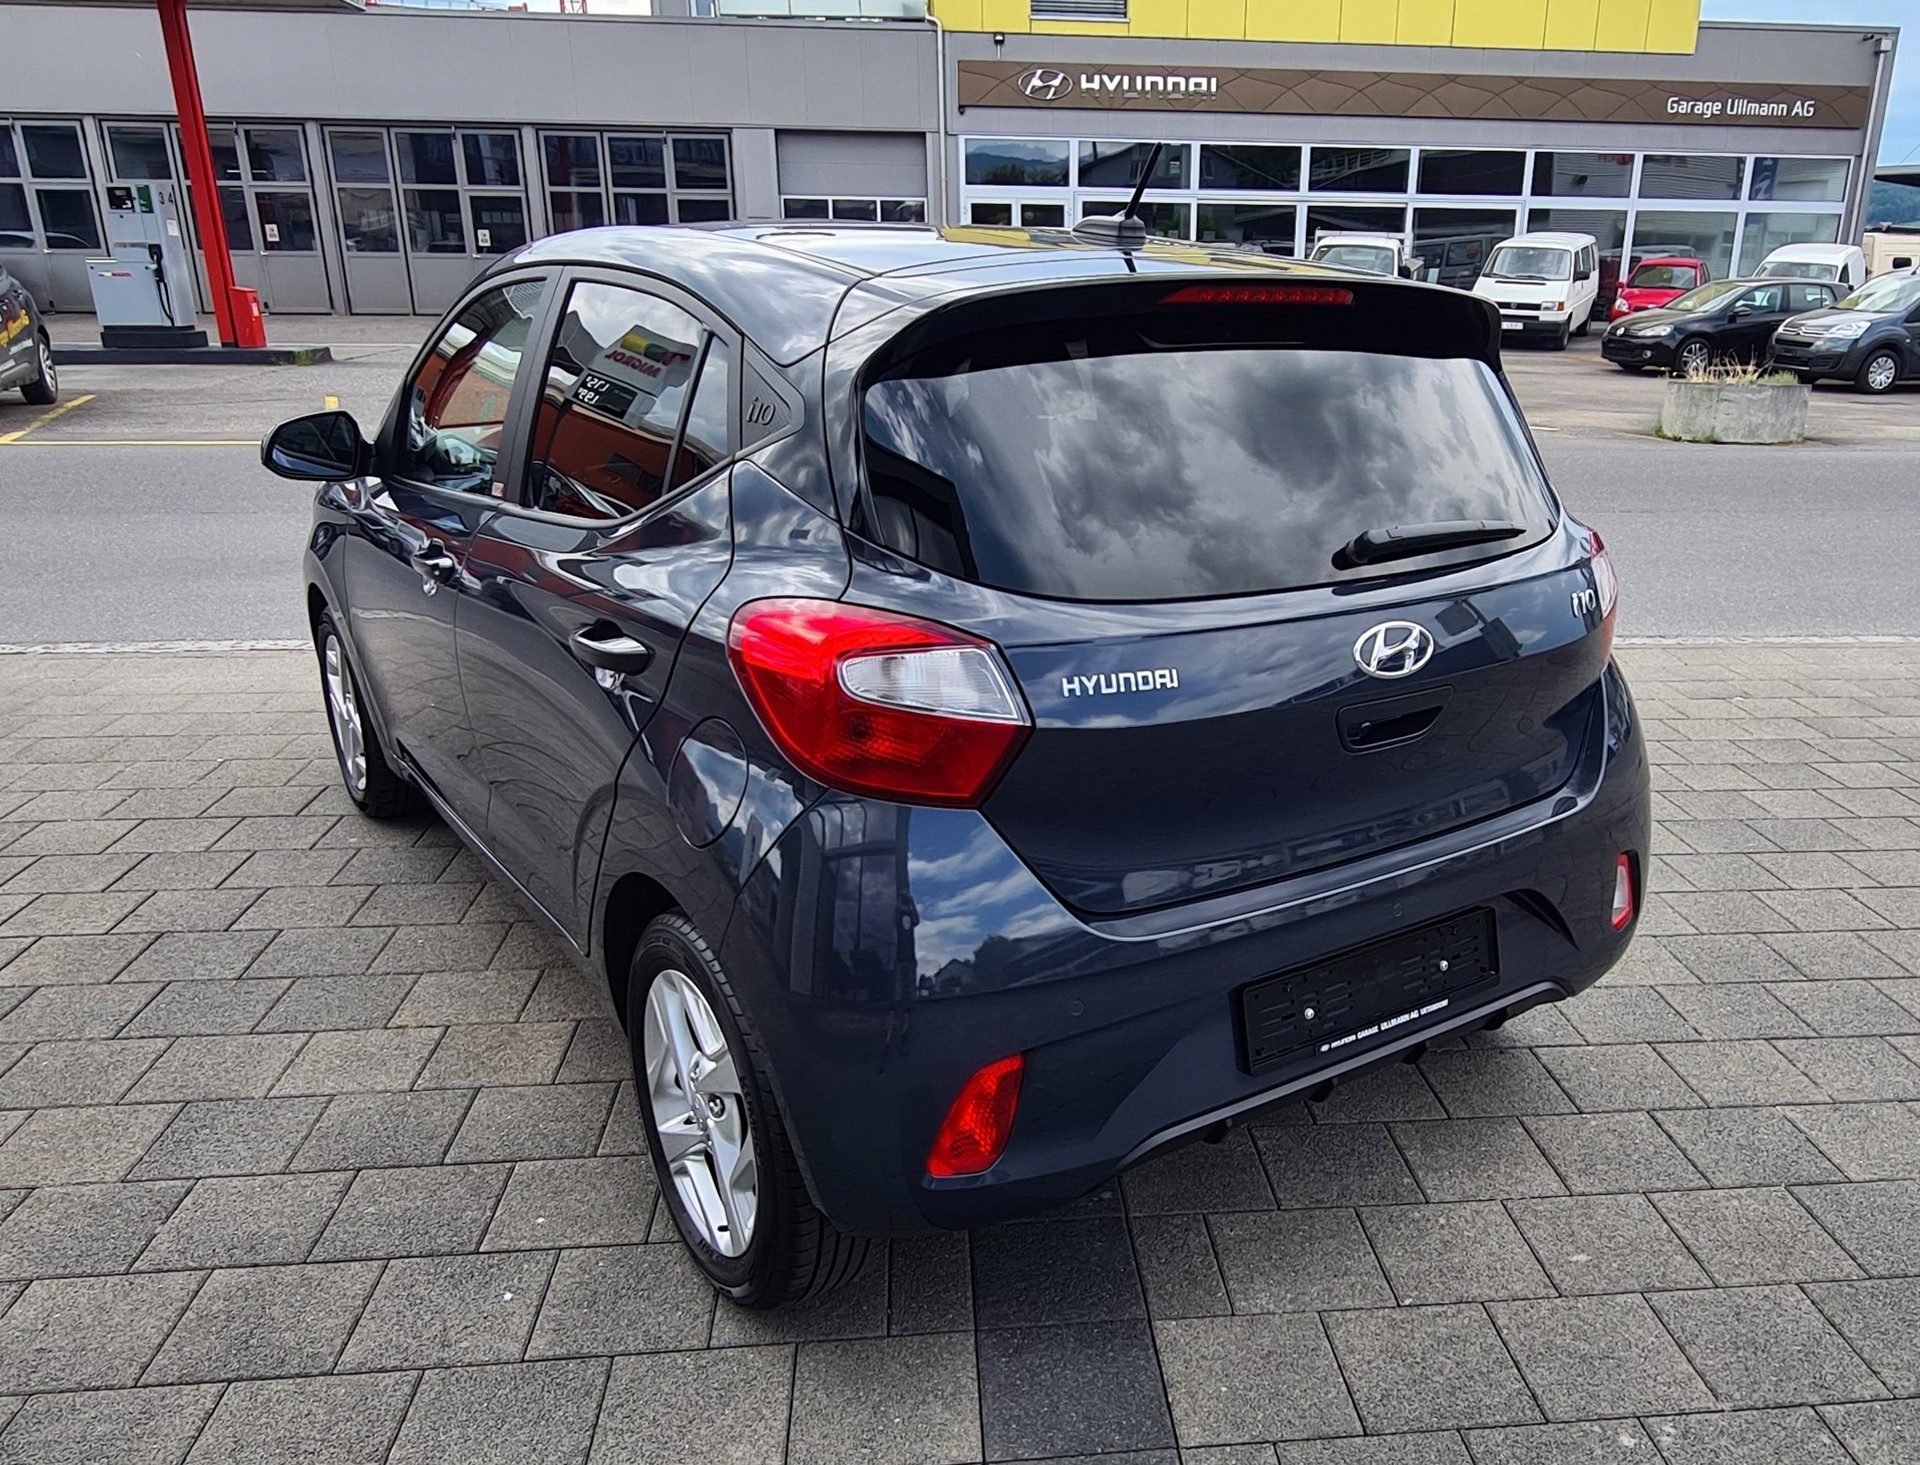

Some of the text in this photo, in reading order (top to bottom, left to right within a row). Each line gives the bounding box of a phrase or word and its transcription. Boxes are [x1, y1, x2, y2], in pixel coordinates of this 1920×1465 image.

[1080, 73, 1217, 100] HYUNDAI
[1666, 97, 1815, 118] Garage Ullmann AG
[158, 191, 166, 205] 3
[746, 396, 776, 426] i10
[1571, 589, 1597, 618] i10
[1061, 668, 1179, 698] HYUNDAI
